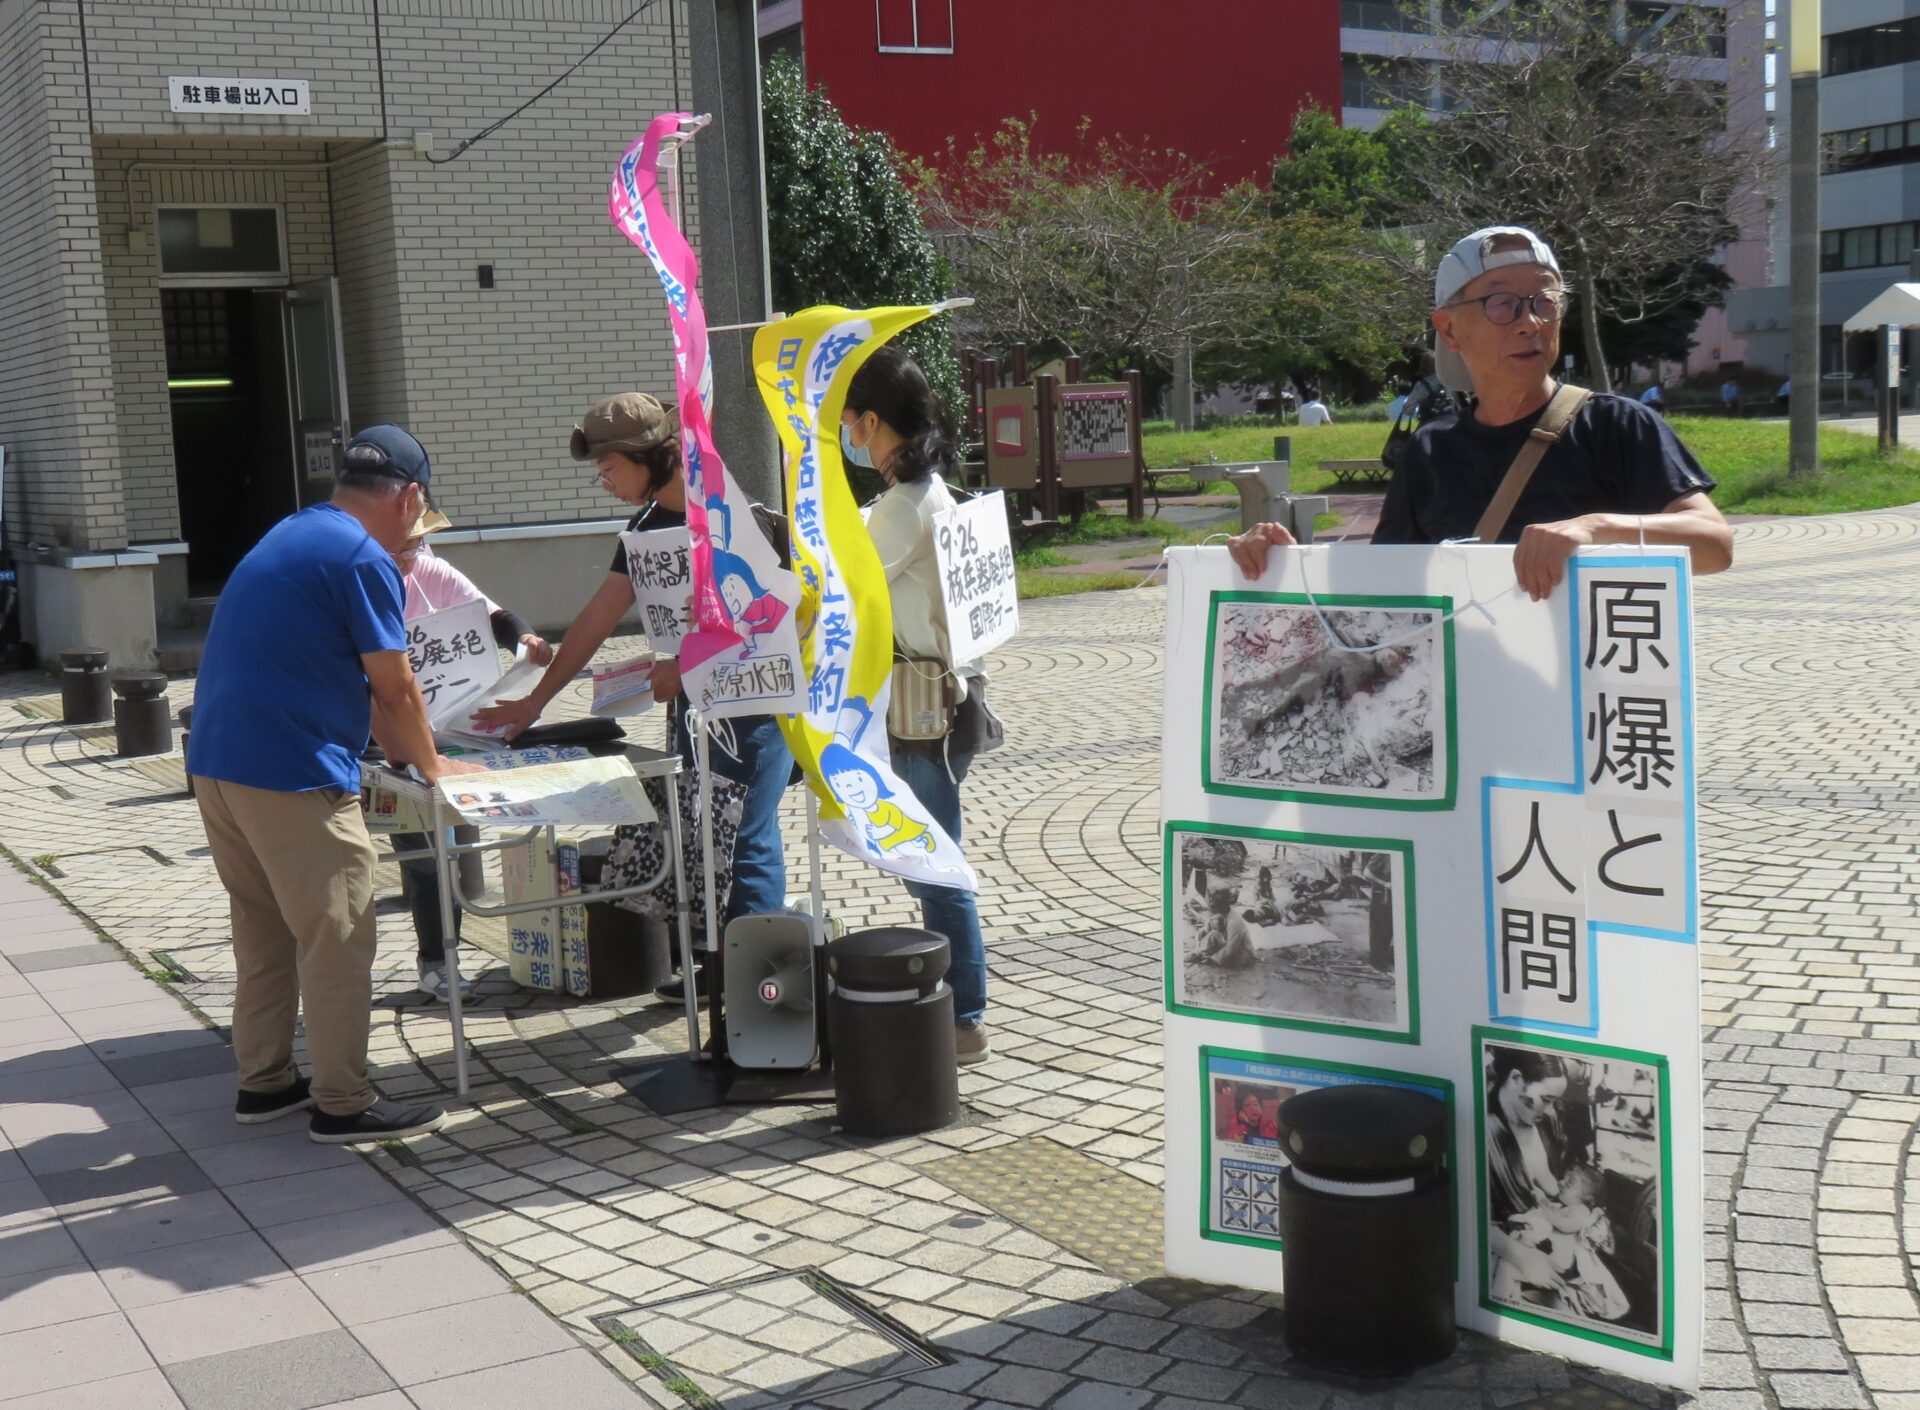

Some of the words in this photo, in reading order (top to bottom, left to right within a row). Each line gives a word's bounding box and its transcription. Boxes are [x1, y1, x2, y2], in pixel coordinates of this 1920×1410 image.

[182, 85, 298, 105] 駐車場出入口
[947, 544, 1014, 609] 核兵器廃絶
[968, 594, 1014, 641] 国際デー
[421, 673, 470, 705] デー
[1584, 579, 1675, 897] 原爆と
[1496, 801, 1577, 1003] 人間
